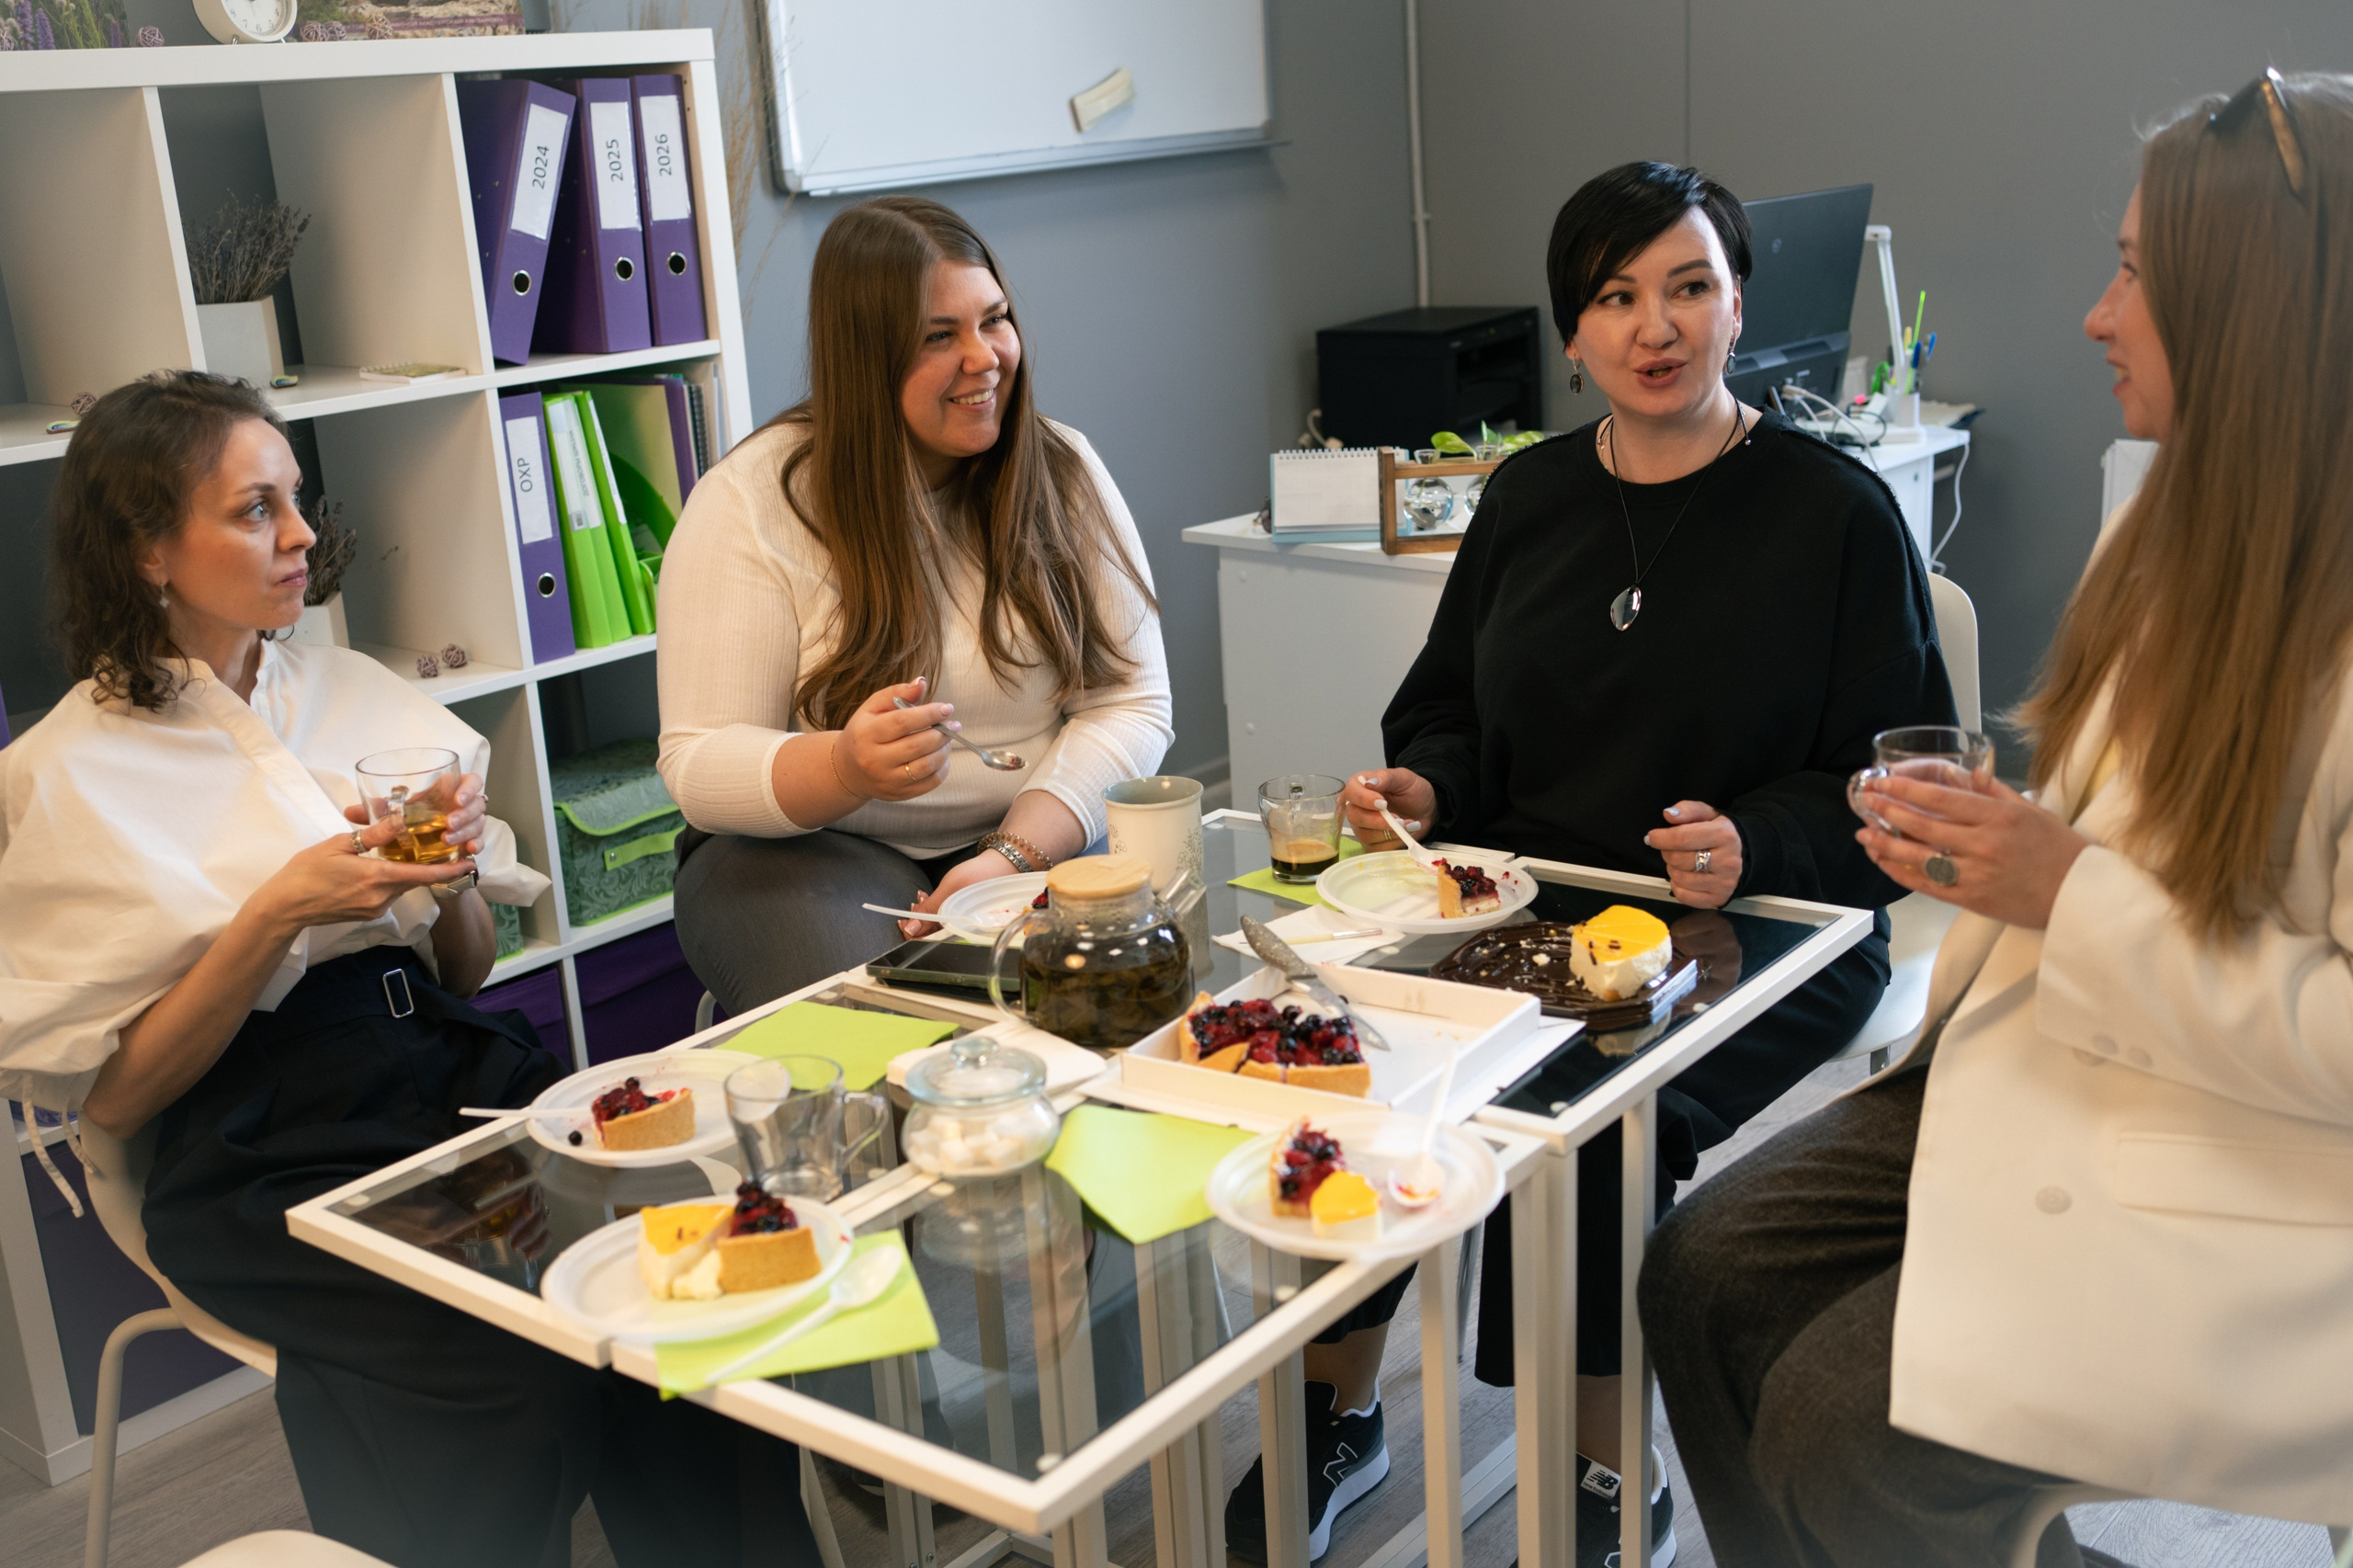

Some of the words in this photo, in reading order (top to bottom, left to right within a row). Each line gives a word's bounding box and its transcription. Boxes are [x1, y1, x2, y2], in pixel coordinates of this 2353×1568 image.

[243, 19, 248, 28] 7
[256, 23, 262, 33] 6
[532, 145, 550, 190] 2024
[606, 139, 623, 182] 2025
[654, 133, 672, 176] 2026
[517, 458, 533, 493] ОХР
